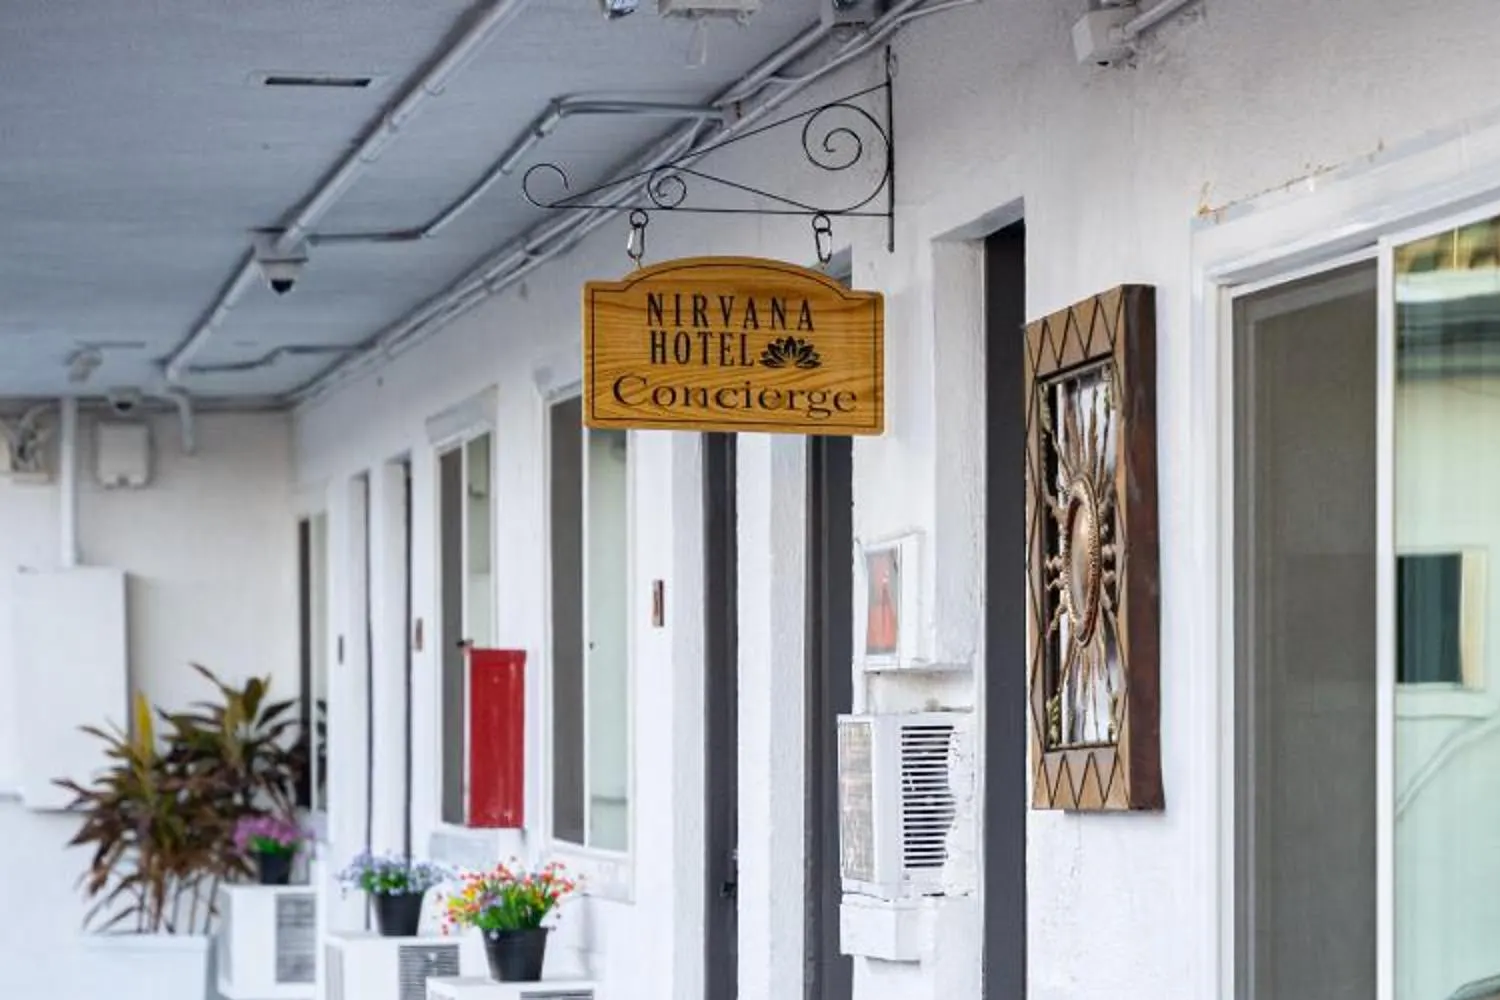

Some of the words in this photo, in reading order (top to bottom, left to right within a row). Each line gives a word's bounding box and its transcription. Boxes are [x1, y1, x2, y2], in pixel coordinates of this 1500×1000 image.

[647, 293, 814, 331] NIRVANA
[651, 331, 754, 367] HOTEL
[612, 374, 857, 421] Concierge
